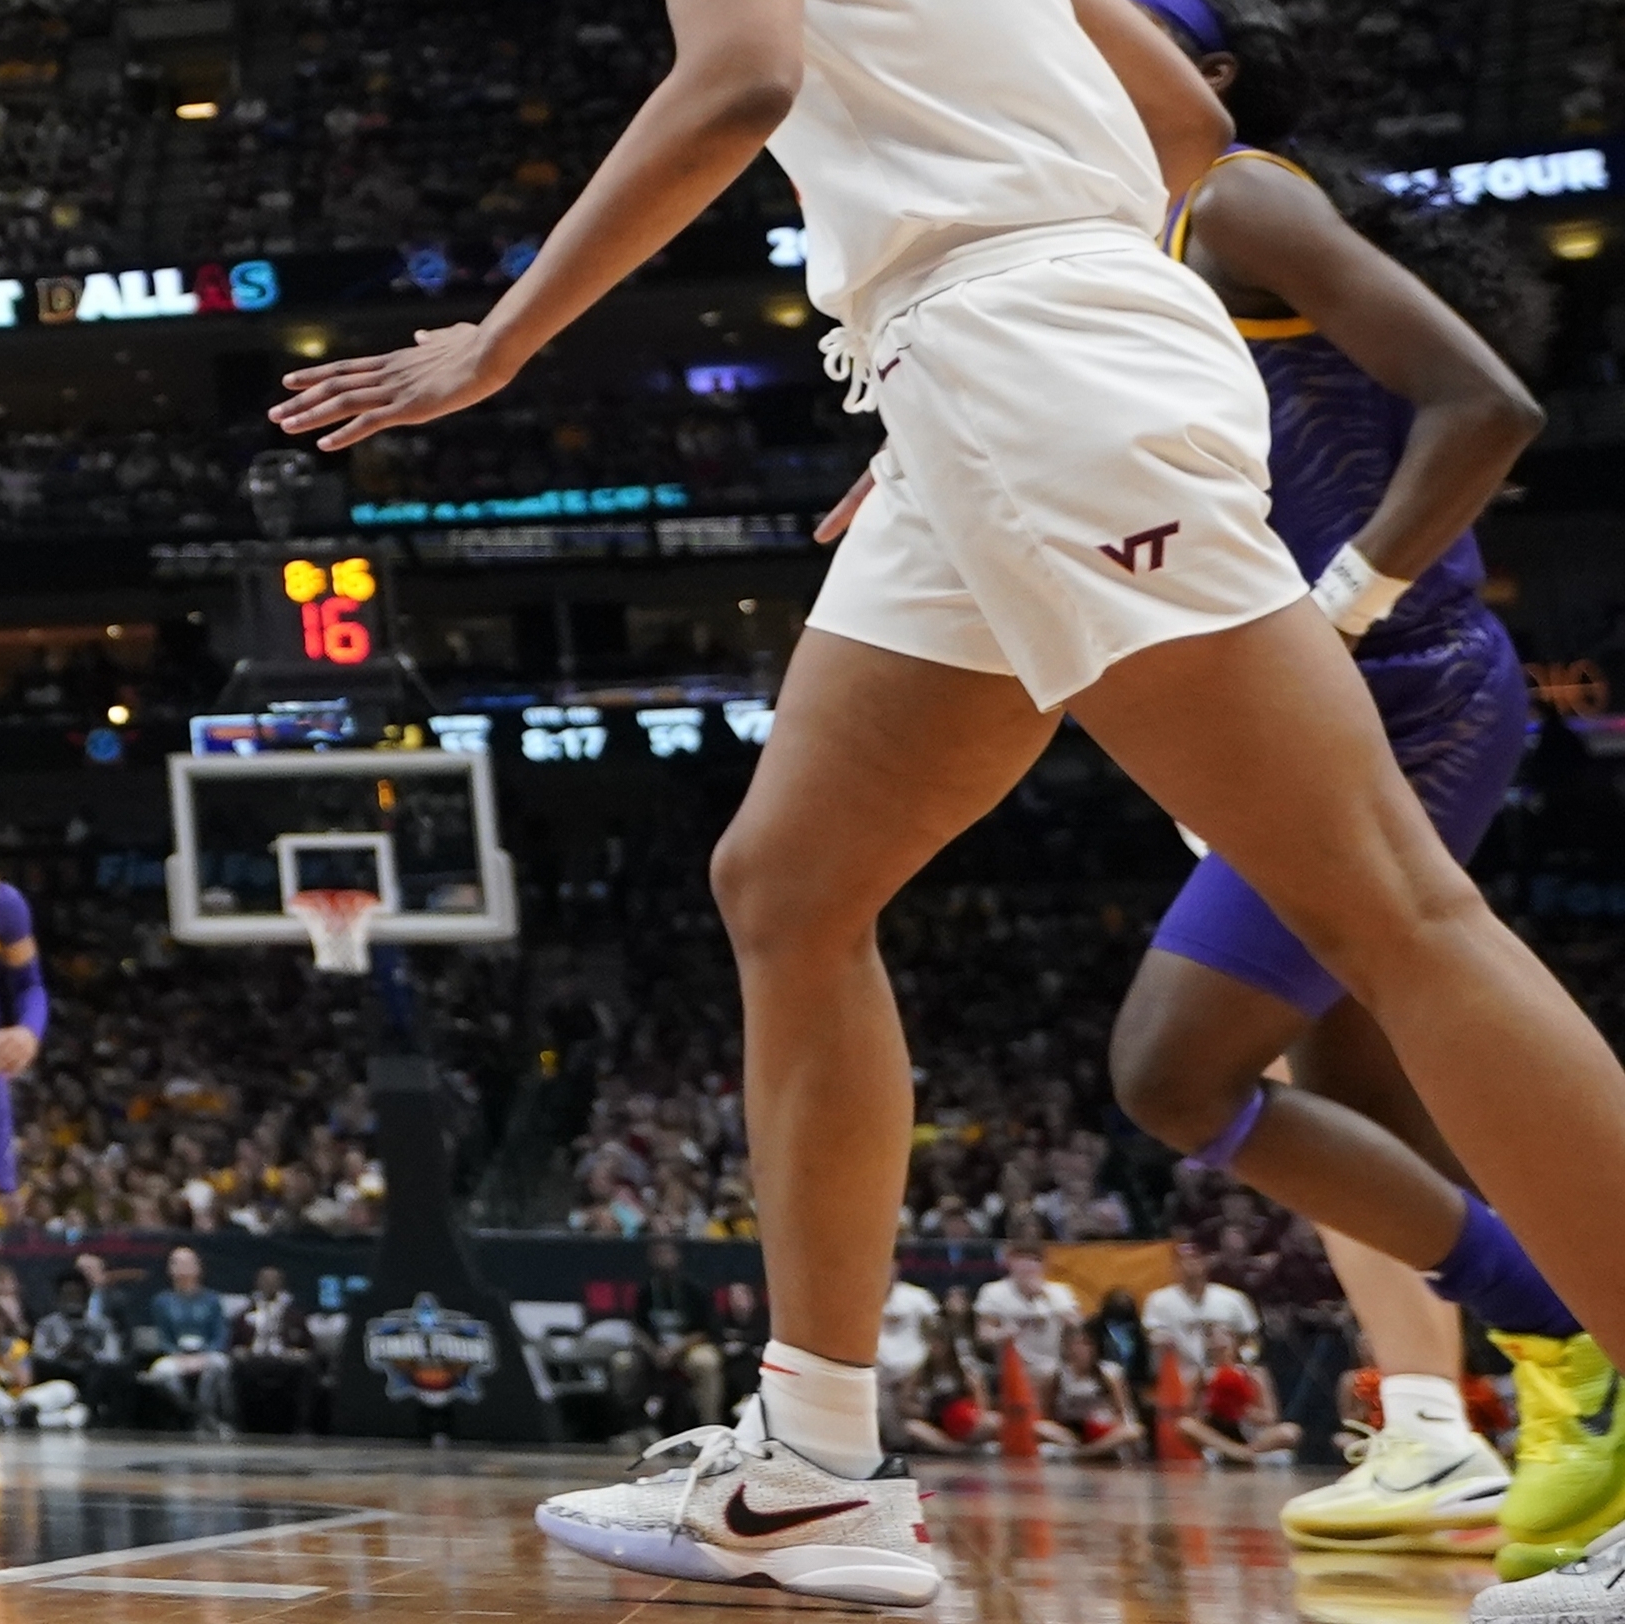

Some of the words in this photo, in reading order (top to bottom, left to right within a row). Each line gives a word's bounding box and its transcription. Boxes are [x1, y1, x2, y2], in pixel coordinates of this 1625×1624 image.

[1449, 148, 1610, 206] FOUR
[36, 260, 279, 325] DALLAS
[1097, 520, 1181, 577] VT
[300, 594, 371, 665] 16
